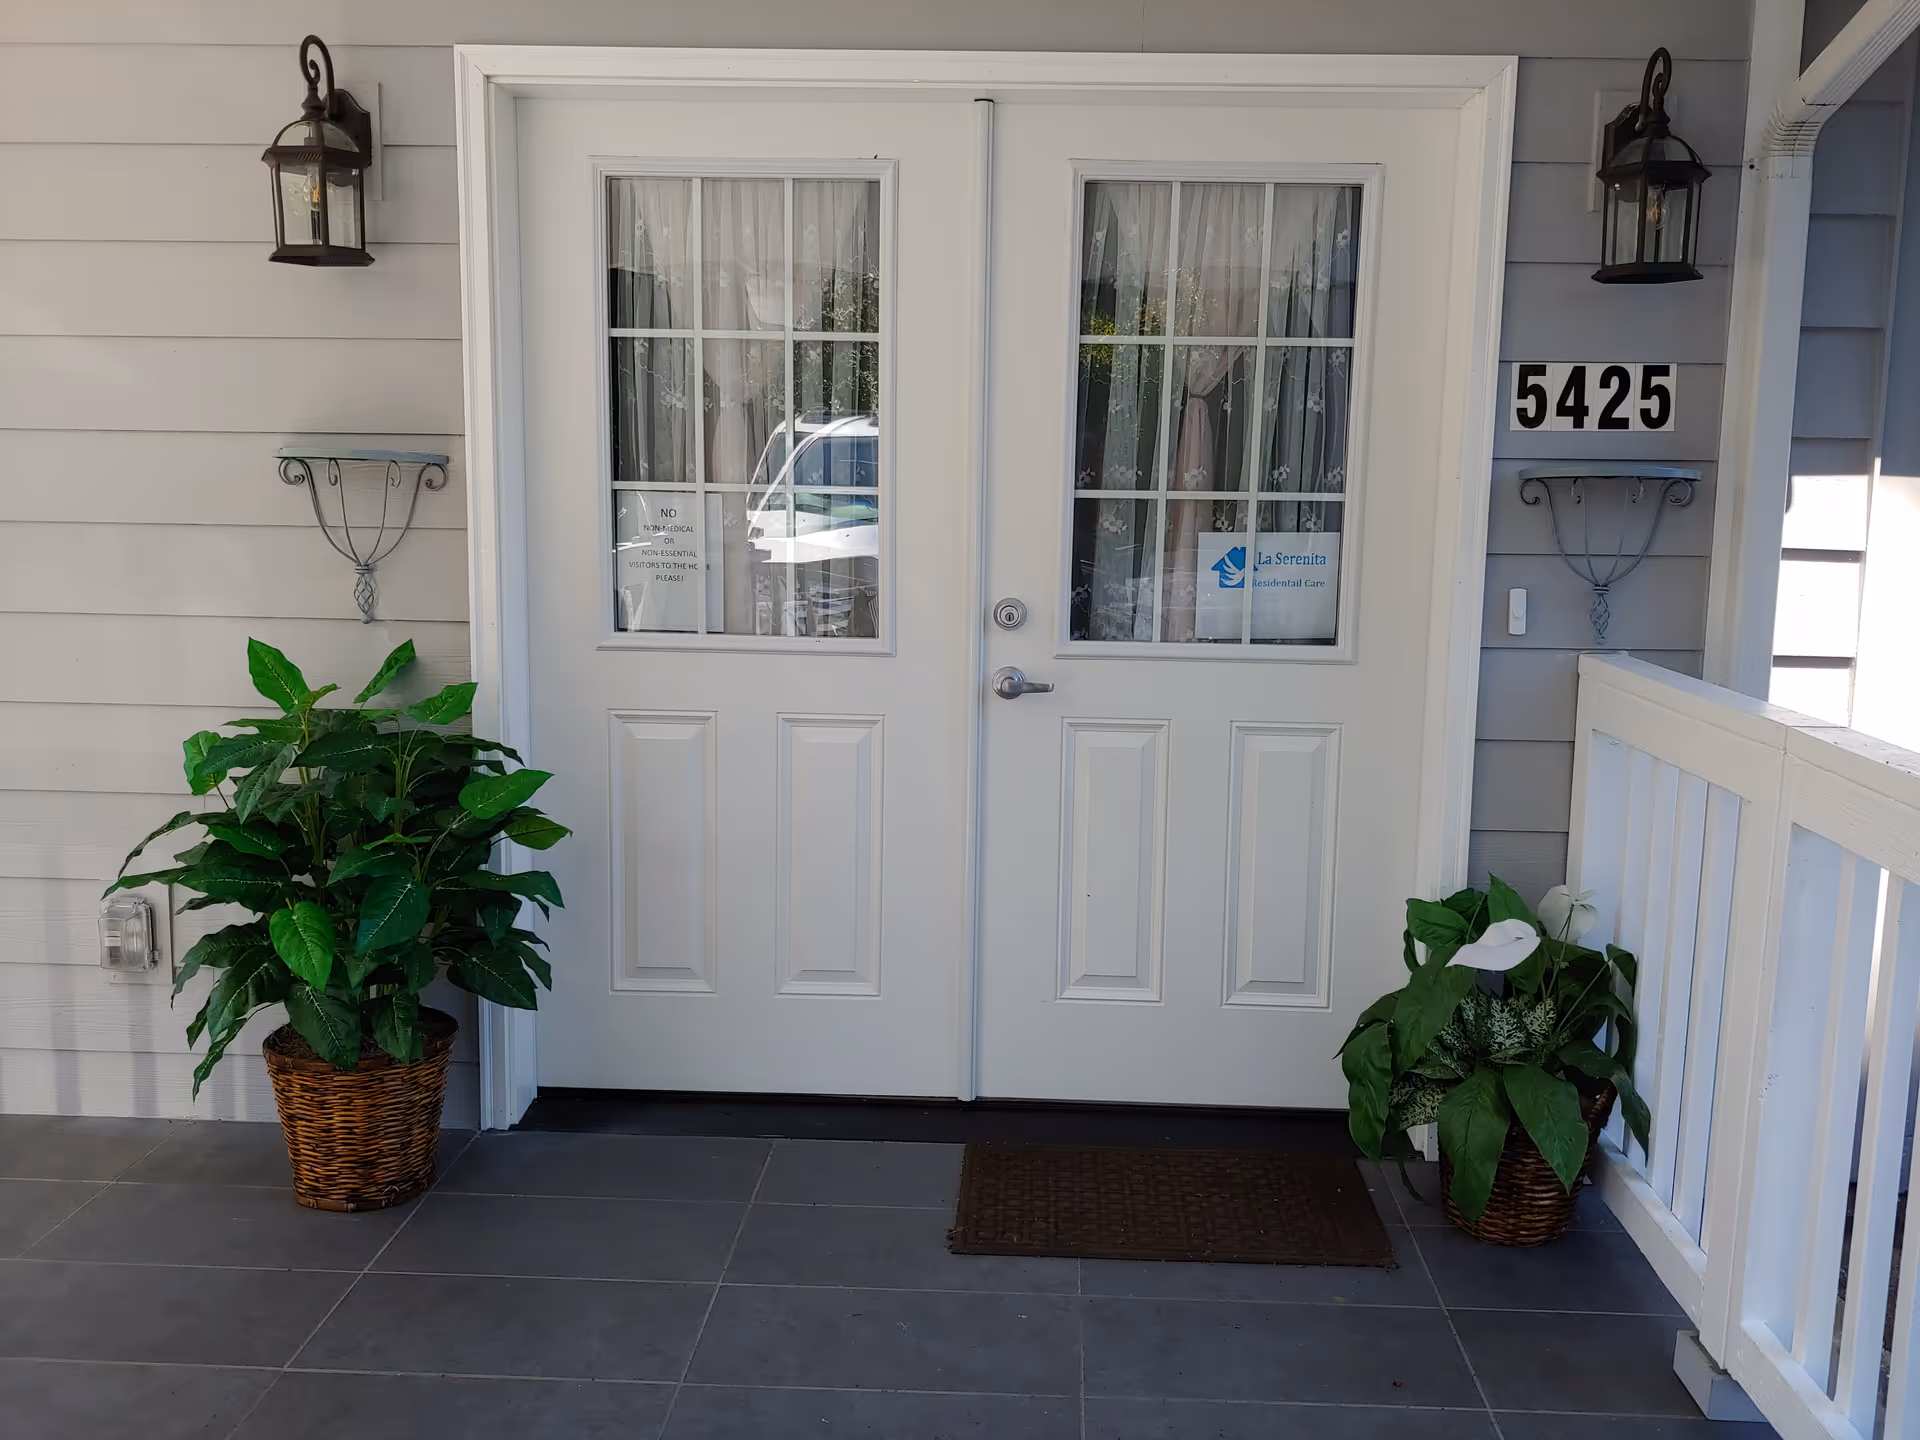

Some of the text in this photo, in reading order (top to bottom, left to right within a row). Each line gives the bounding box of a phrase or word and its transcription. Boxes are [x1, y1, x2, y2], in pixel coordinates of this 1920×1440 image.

[1516, 364, 1671, 430] 5425
[660, 508, 677, 518] NO
[643, 524, 695, 533] NON-MEDICAL
[641, 549, 698, 558] NON-ESSENTIAL
[1257, 552, 1326, 565] La Serenita
[628, 561, 660, 569] VISITORS
[655, 574, 684, 582] PLEASE!
[1304, 579, 1326, 588] Care
